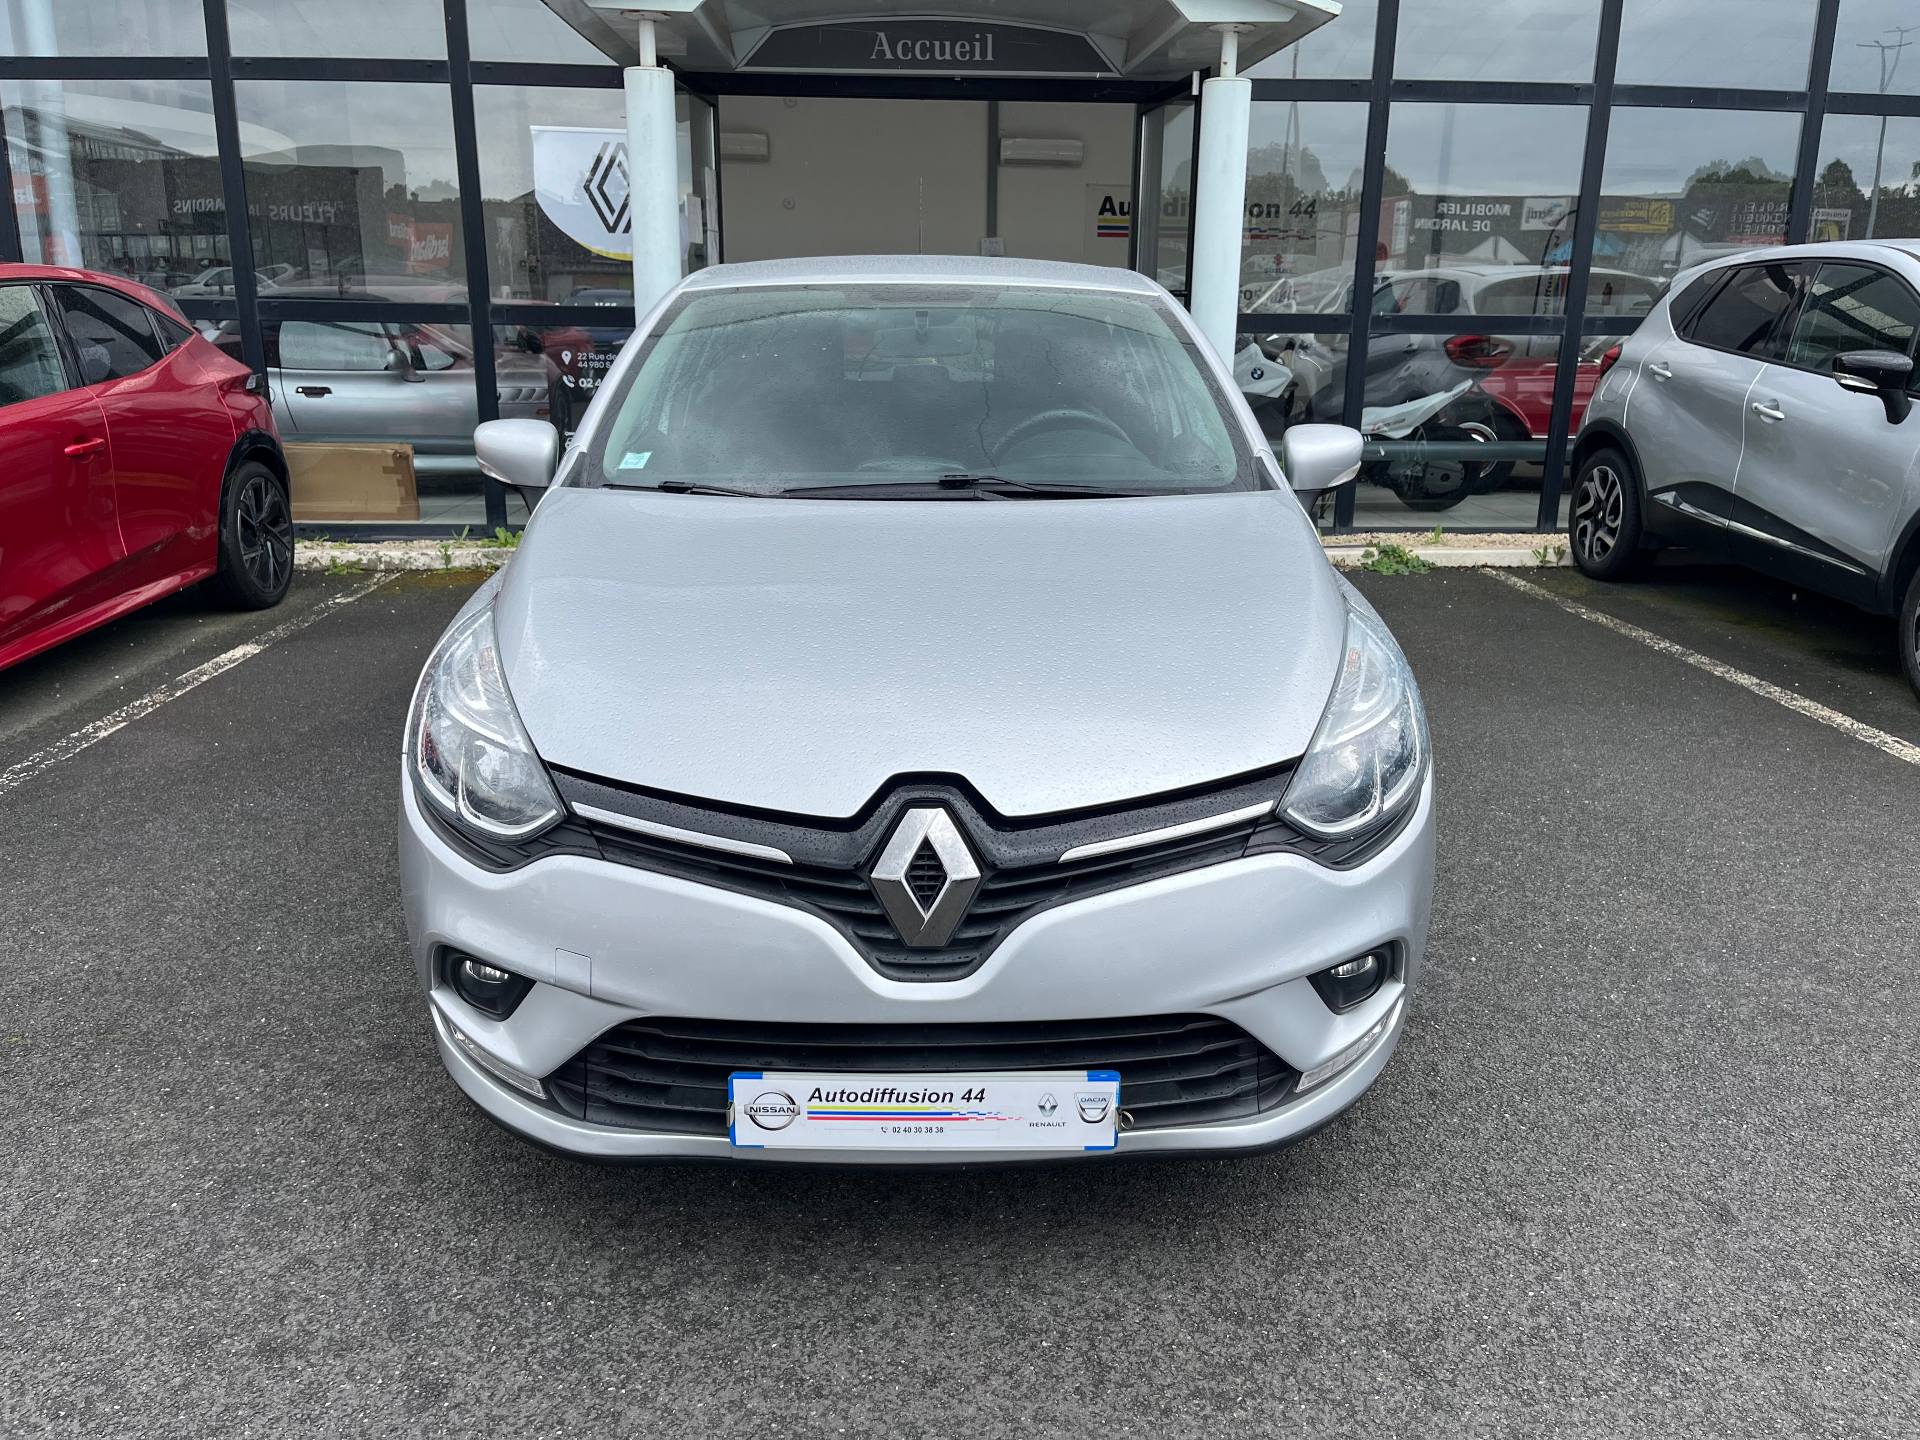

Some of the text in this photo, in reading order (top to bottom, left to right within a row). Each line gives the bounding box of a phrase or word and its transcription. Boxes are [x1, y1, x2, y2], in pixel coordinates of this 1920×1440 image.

[869, 31, 995, 61] Accueil
[1289, 199, 1317, 219] 44
[577, 352, 588, 361] 22
[588, 352, 605, 361] Rue
[588, 361, 605, 369] 980
[578, 377, 594, 388] 02
[807, 1087, 986, 1104] Autodiffusion 44
[749, 1106, 796, 1114] NISSAN
[892, 1126, 944, 1134] 02 40 30 38 38
